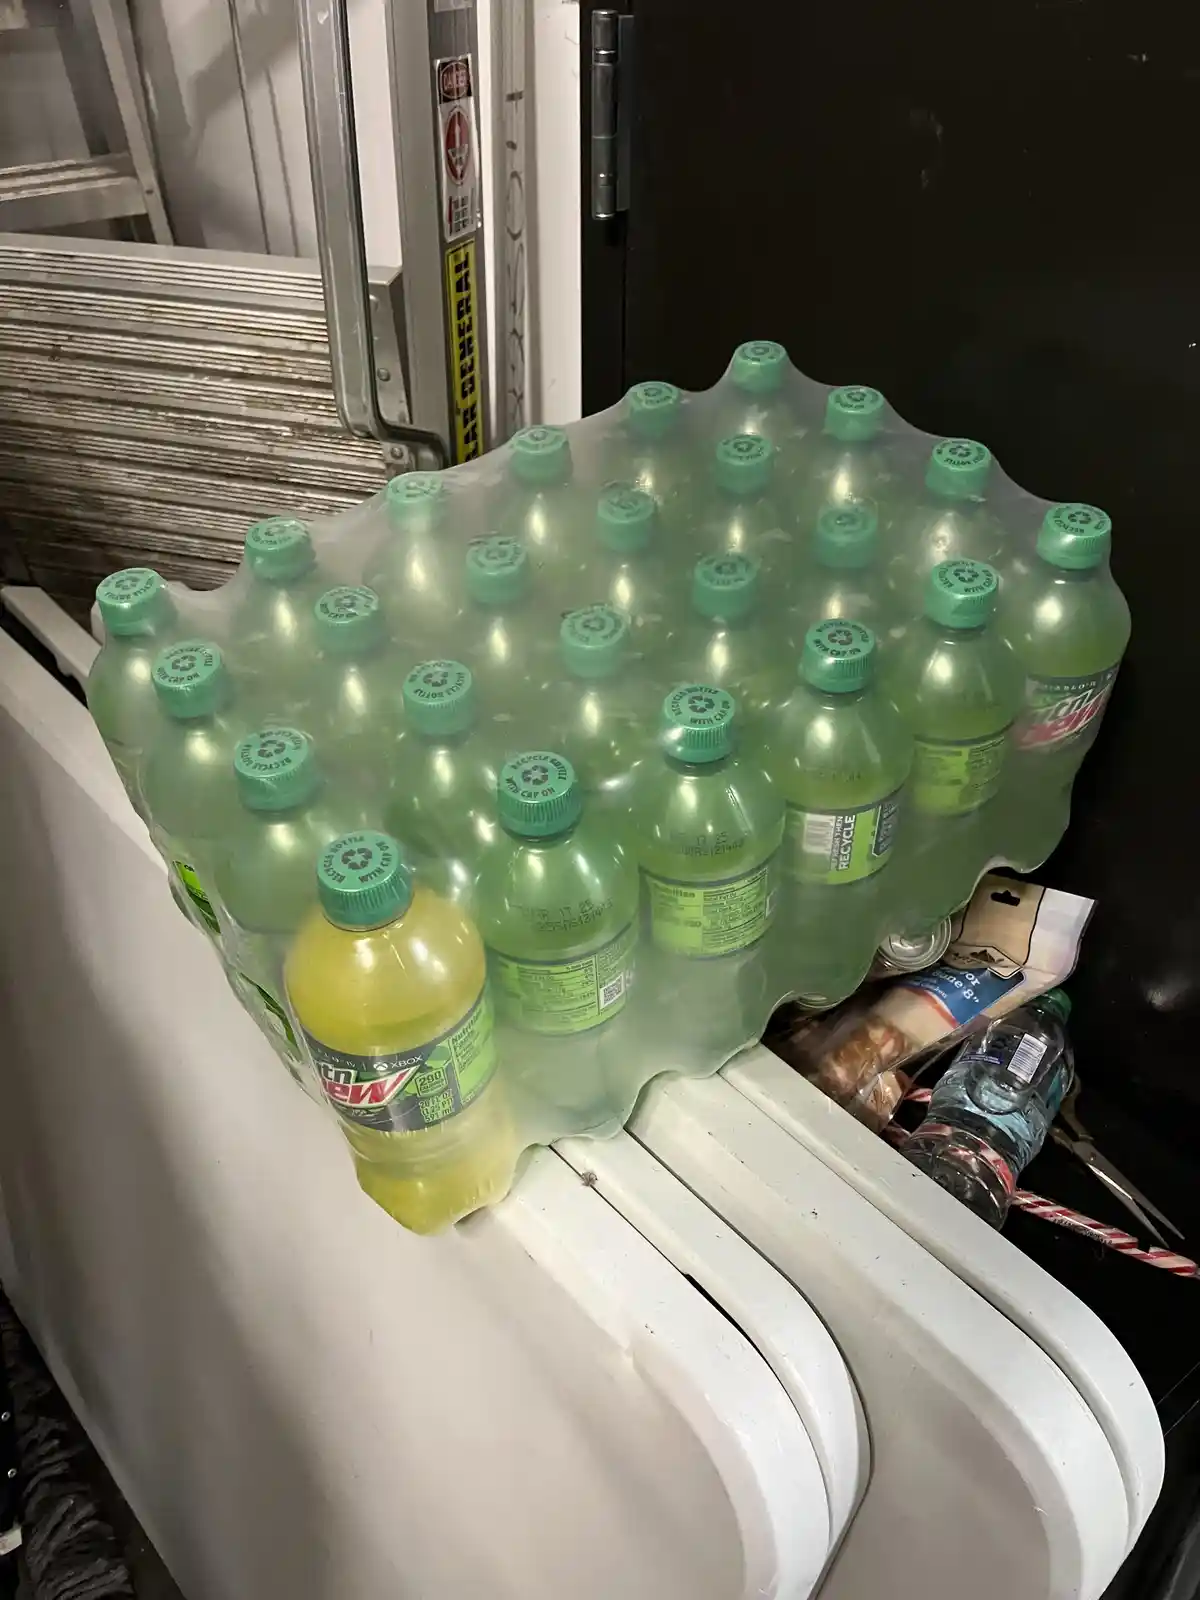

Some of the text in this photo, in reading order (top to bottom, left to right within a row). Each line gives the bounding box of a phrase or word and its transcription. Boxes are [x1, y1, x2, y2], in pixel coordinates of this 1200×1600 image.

[454, 251, 476, 401] GENERAL
[838, 814, 856, 870] RECYCLE
[389, 1054, 425, 1069] XBOX
[418, 1070, 442, 1087] 290
